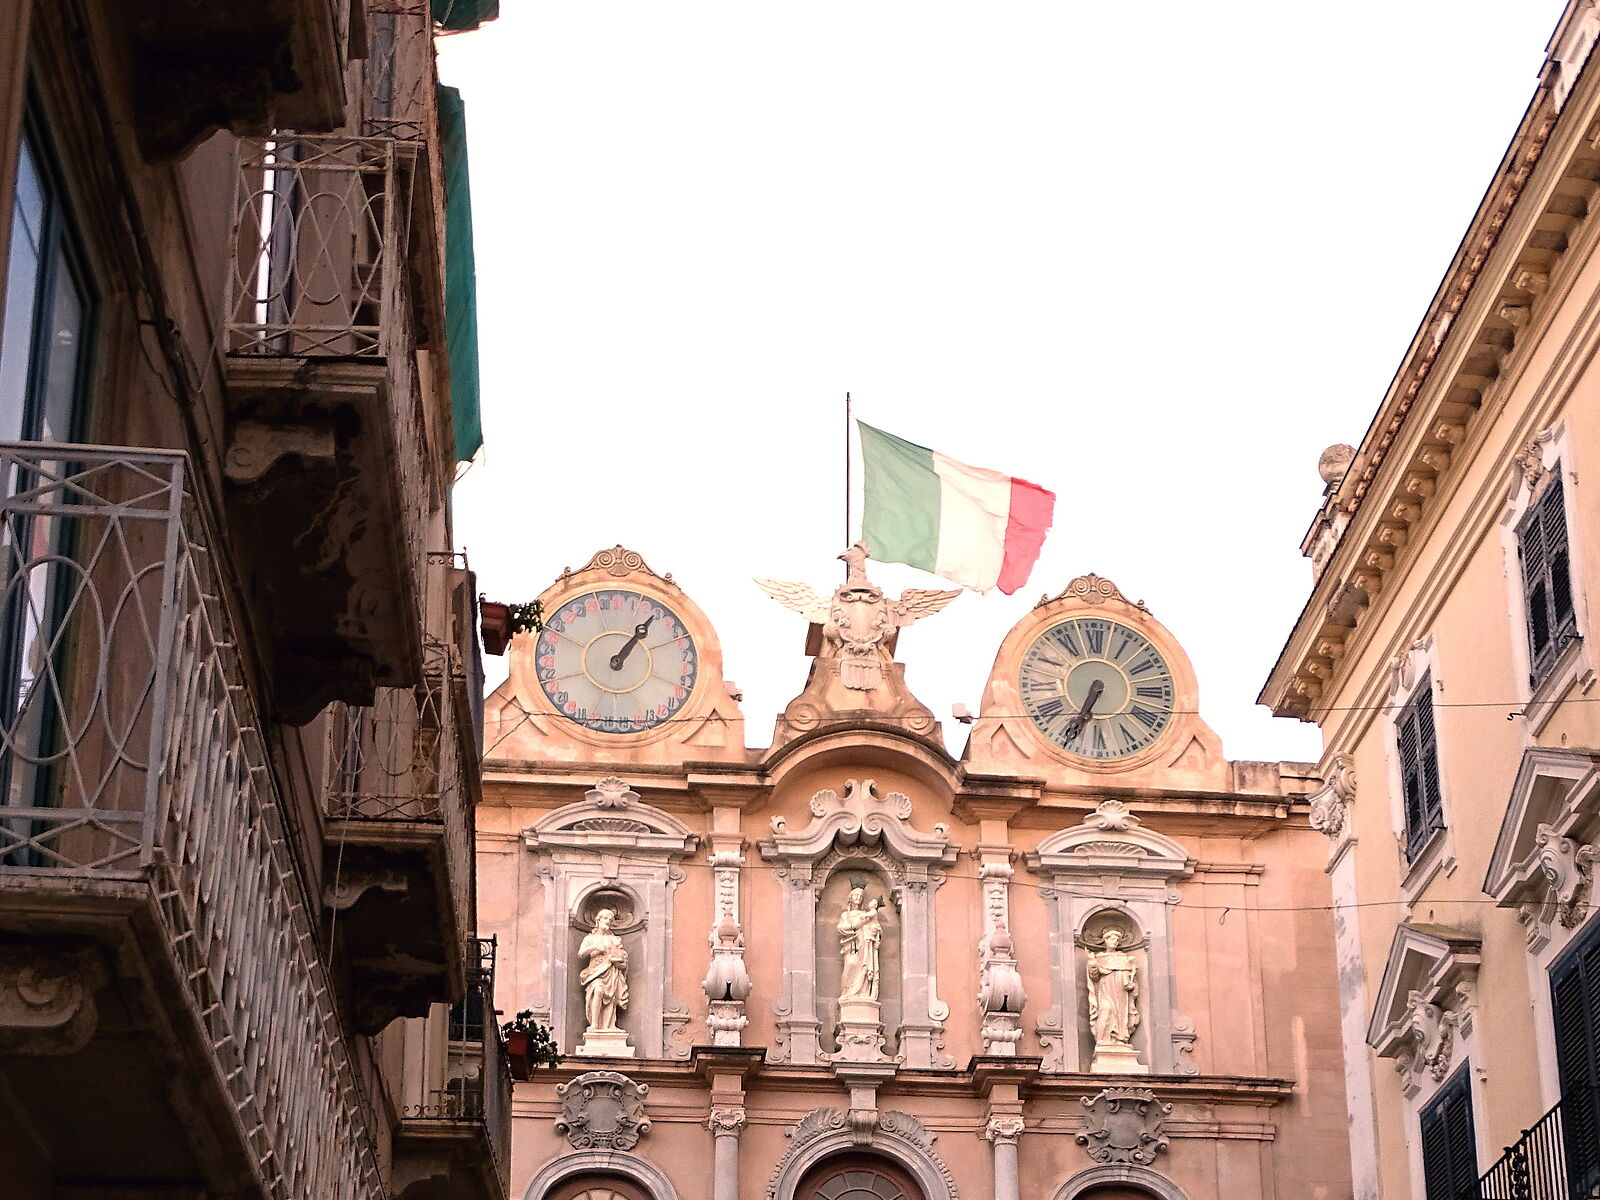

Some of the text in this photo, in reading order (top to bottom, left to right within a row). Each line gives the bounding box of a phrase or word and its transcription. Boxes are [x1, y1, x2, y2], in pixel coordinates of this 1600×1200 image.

[673, 627, 679, 638] 5
[1056, 633, 1080, 657] XI
[1085, 629, 1104, 655] XII
[544, 643, 556, 655] 24
[683, 649, 689, 661] 7
[1113, 639, 1130, 660] I
[1129, 659, 1155, 676] II
[680, 675, 686, 686] 9
[558, 691, 569, 703] 20
[1136, 686, 1163, 699] III
[567, 701, 577, 712] 19
[668, 696, 675, 708] 11
[646, 709, 655, 721] 13
[658, 704, 667, 716] 12
[1092, 724, 1107, 750] VI
[1119, 722, 1137, 746] V
